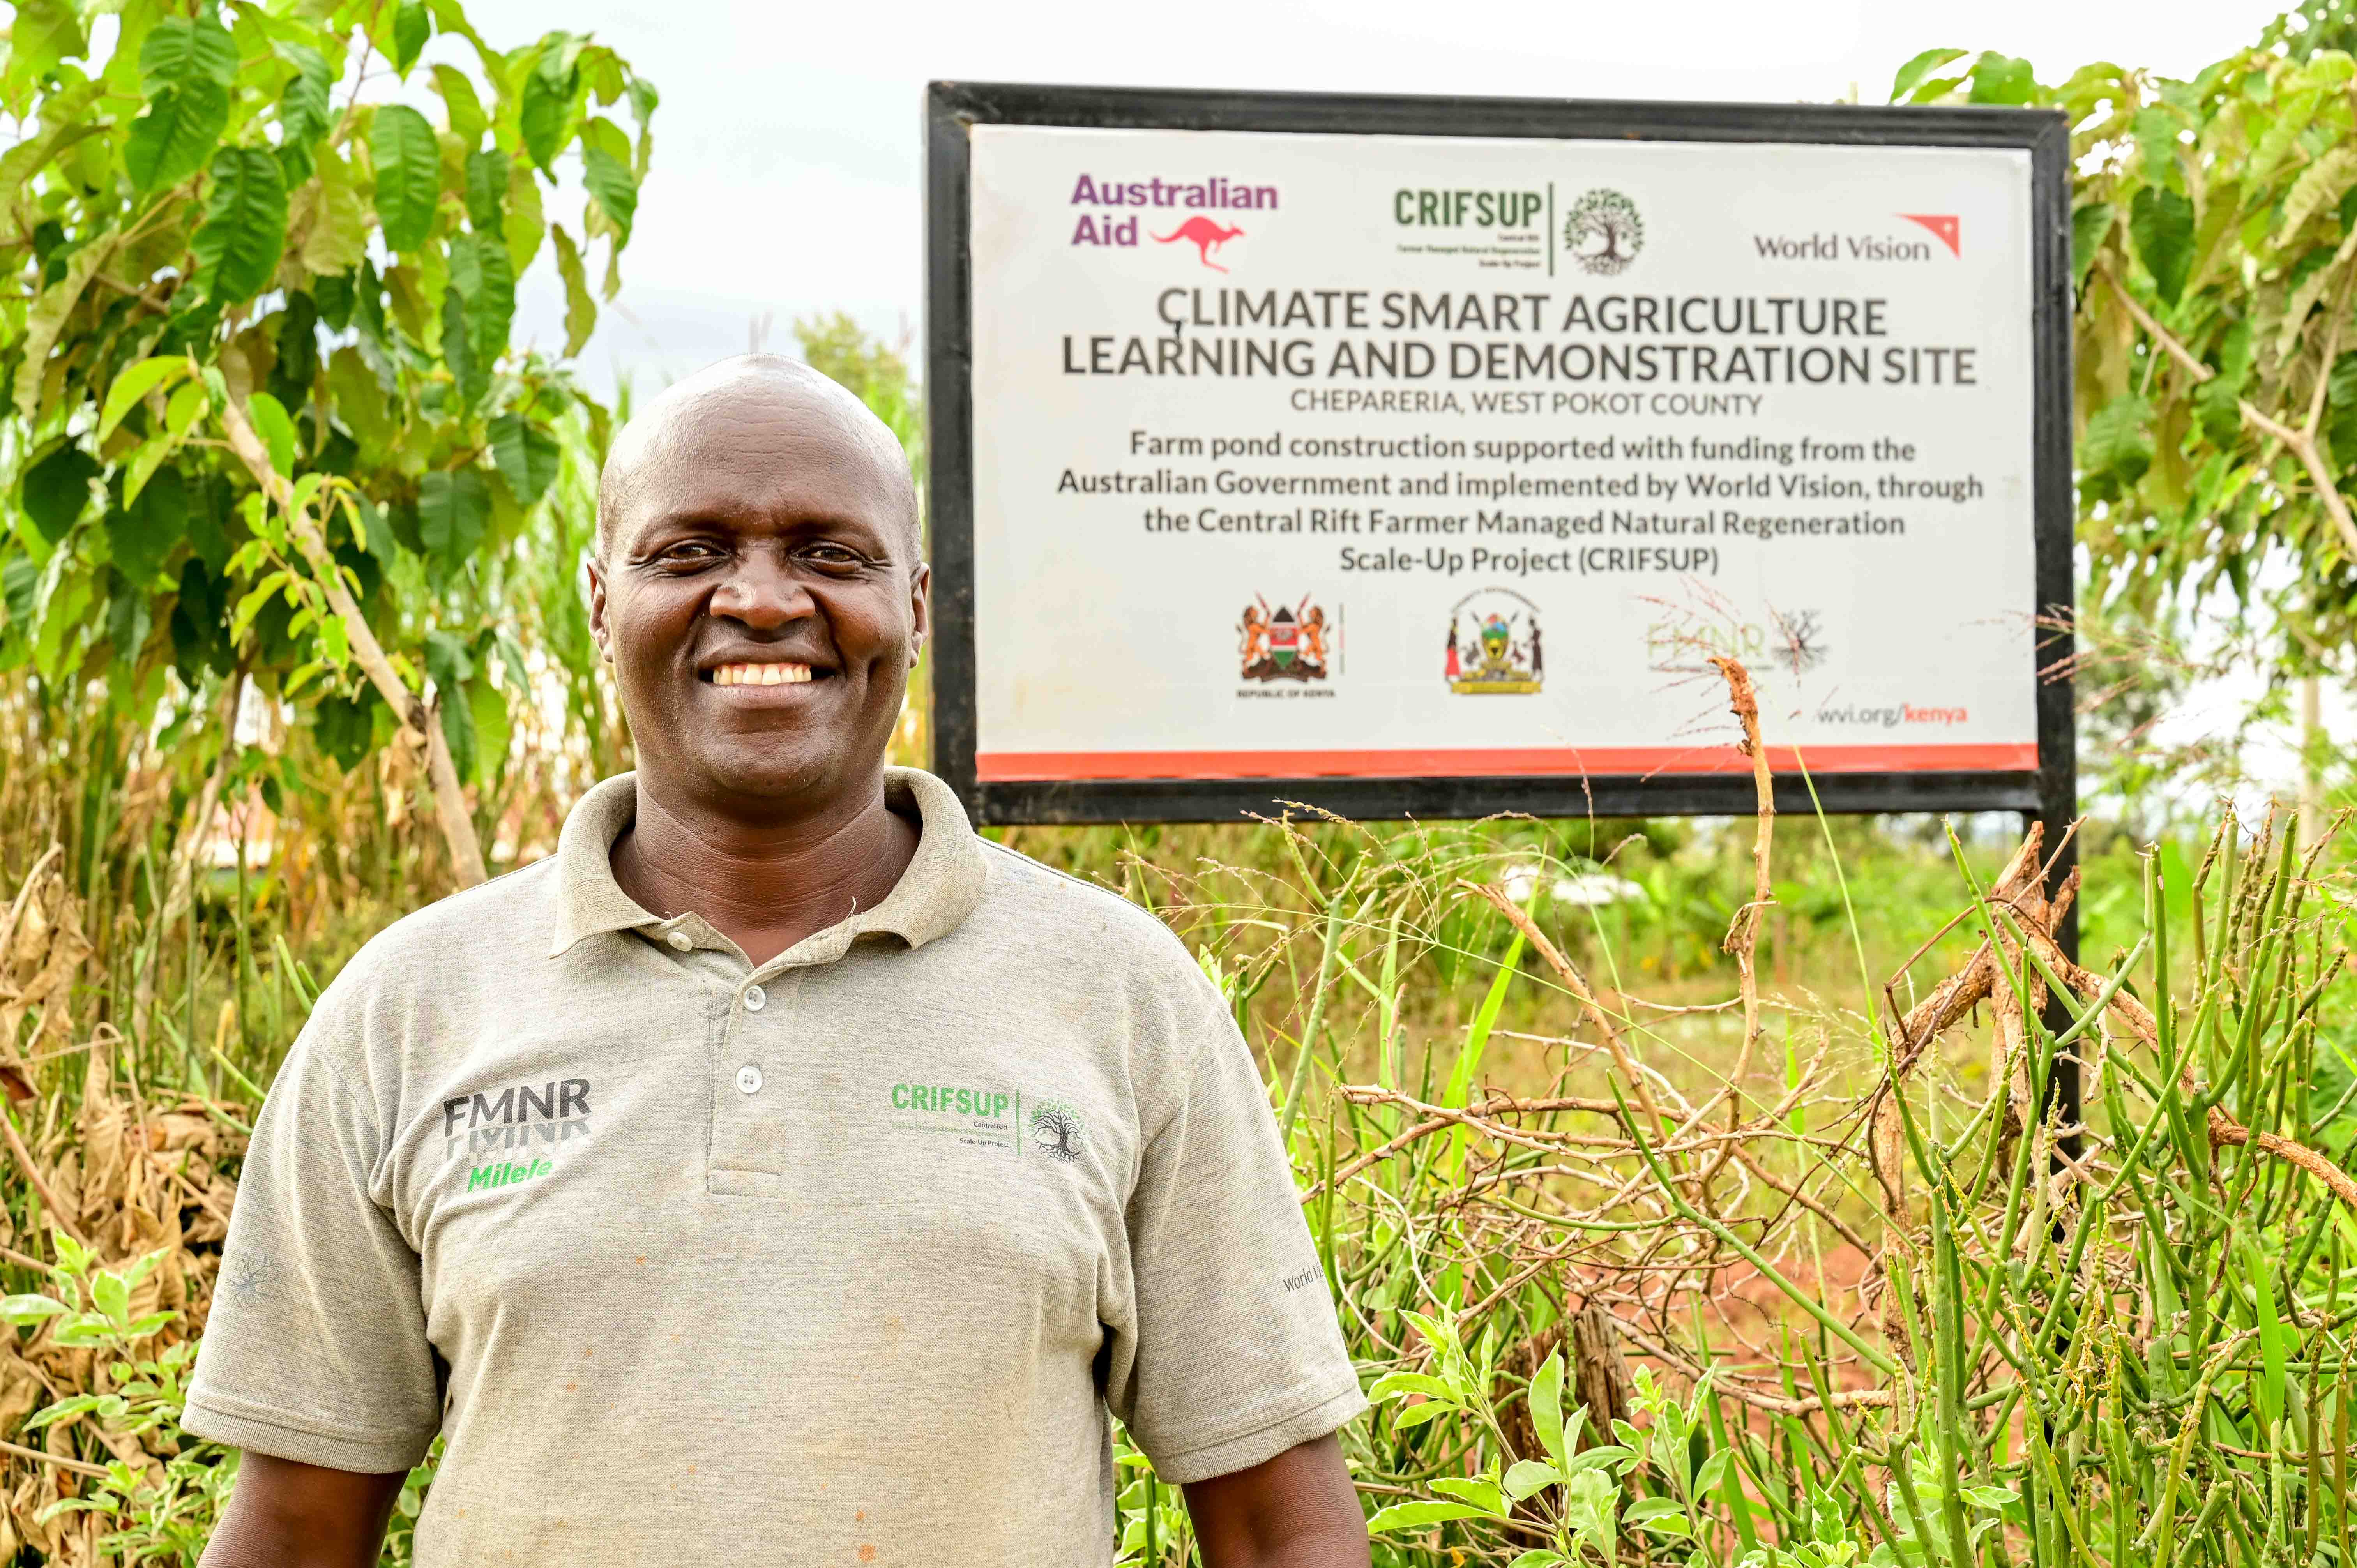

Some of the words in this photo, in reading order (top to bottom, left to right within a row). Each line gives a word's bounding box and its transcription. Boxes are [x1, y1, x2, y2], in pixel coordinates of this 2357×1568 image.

[1071, 174, 1278, 210] Australian
[1394, 189, 1542, 228] CRIFSUP
[1071, 214, 1138, 247] Aid
[1754, 234, 1838, 260] World
[1847, 235, 1930, 261] Vision
[1157, 288, 1369, 328] CLIMATE
[1382, 291, 1551, 332] SMART
[1562, 295, 1887, 336] AGRICULTURE
[1063, 334, 1314, 378] LEARNING
[1327, 340, 1436, 379] AND
[1450, 342, 1869, 384] DEMONSTRATION
[1883, 347, 1977, 385] SITE
[1291, 388, 1465, 415] CHEPARERIA,
[1472, 391, 1545, 413] WEST
[1553, 392, 1645, 415] POKOT
[1650, 393, 1763, 416] COUNTY
[1131, 430, 1203, 455] Farm
[1212, 432, 1281, 461] pond
[1289, 434, 1466, 458] construction
[1474, 435, 1614, 463] supported
[1622, 436, 1683, 460] with
[1691, 436, 1793, 466] funding
[1800, 437, 1864, 461] from
[1872, 437, 1915, 461] the
[1057, 468, 1207, 493] Australian
[1215, 470, 1391, 496] Government
[1399, 472, 1448, 496] and
[1458, 471, 1638, 501] implemented
[1647, 472, 1678, 502] by
[1686, 474, 1770, 497] World
[1778, 474, 1870, 501] Vision,
[1877, 474, 1983, 503] through
[1144, 507, 1190, 532] the
[1197, 508, 1302, 533] Central
[1311, 509, 1360, 533] Rift
[1369, 509, 1468, 533] Farmer
[1477, 510, 1603, 539] Managed
[1612, 510, 1714, 534] Natural
[1723, 511, 1905, 539] Regeneration
[1341, 547, 1463, 576] Scale-Up
[1472, 547, 1571, 577] Project
[1579, 547, 1718, 575] (CRIFSUP)
[1817, 703, 1968, 728] wvi.org/kenya
[443, 1078, 592, 1137] FMNR
[892, 1082, 1009, 1119] CRIFSUP
[468, 1158, 554, 1192] Milele
[1283, 1265, 1314, 1293] World
